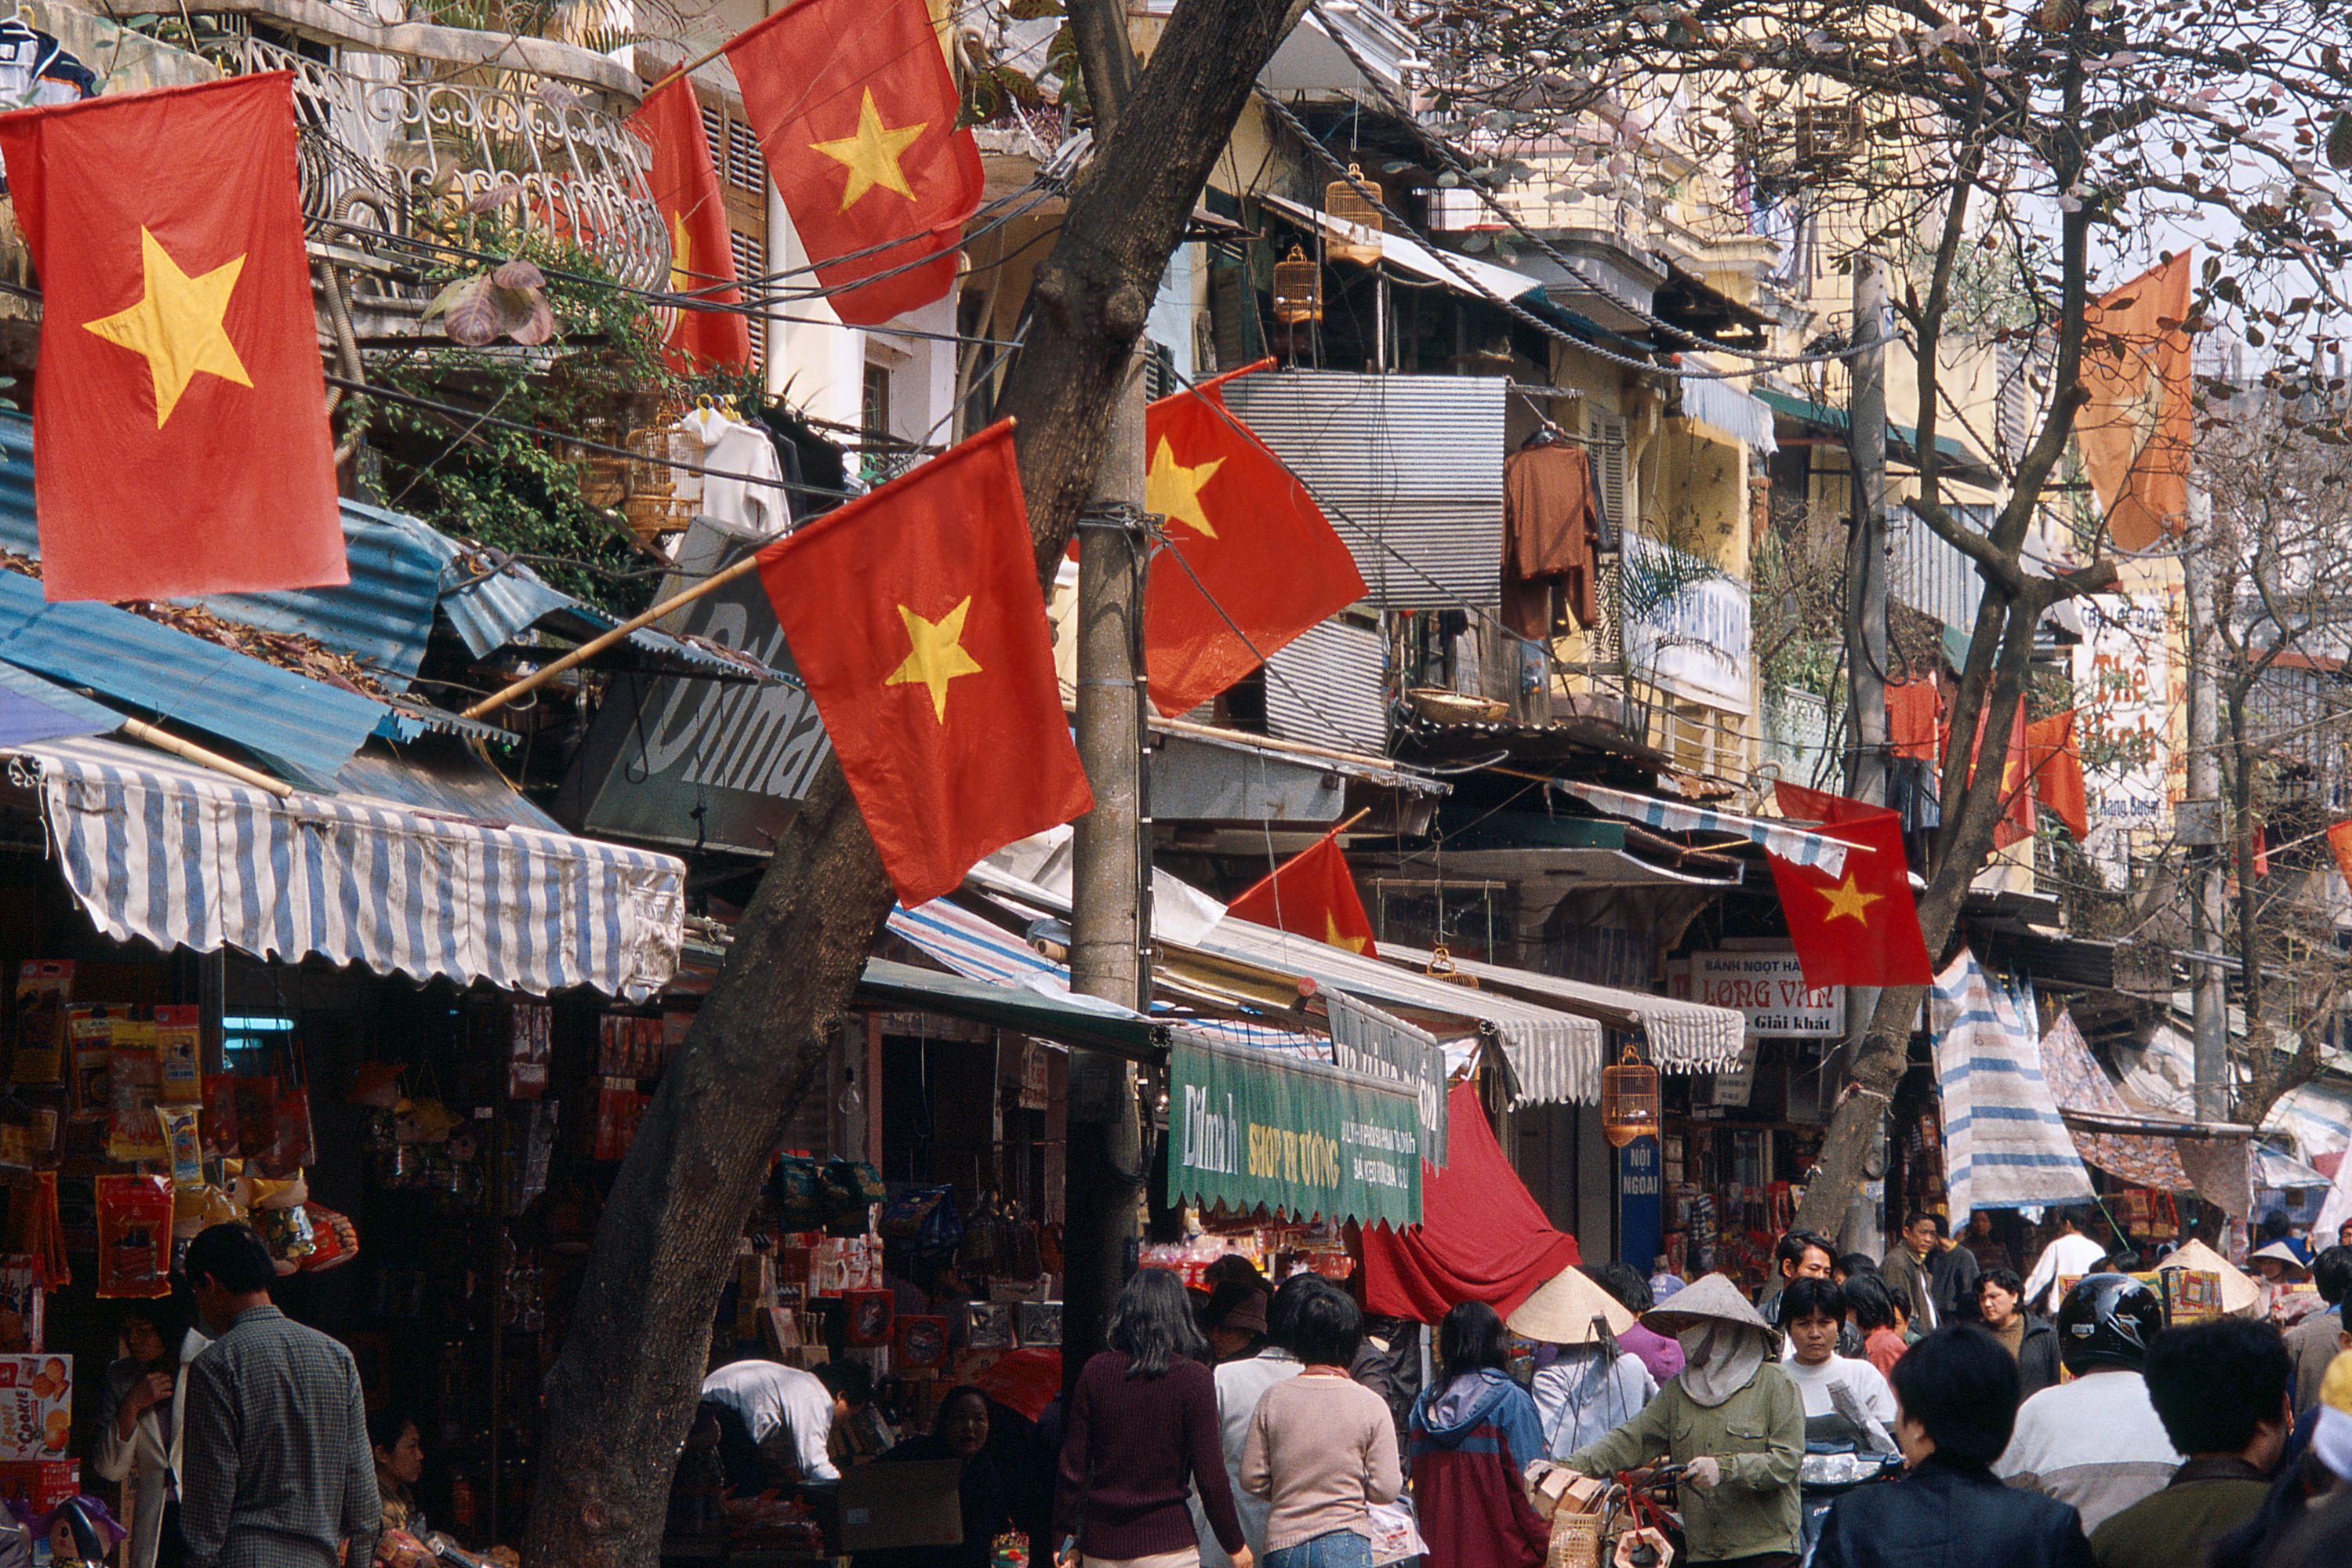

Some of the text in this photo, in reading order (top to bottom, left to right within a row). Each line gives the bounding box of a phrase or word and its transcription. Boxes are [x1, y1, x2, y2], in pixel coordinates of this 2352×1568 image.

[631, 601, 833, 801] Dilma
[1744, 960, 1780, 975] NGỌT
[1702, 979, 1770, 1008] LONG
[1794, 1015, 1831, 1030] khát
[1183, 1084, 1238, 1176] Dilmah
[1248, 1122, 1282, 1179] SHOP
[1631, 1143, 1650, 1171] NỘI
